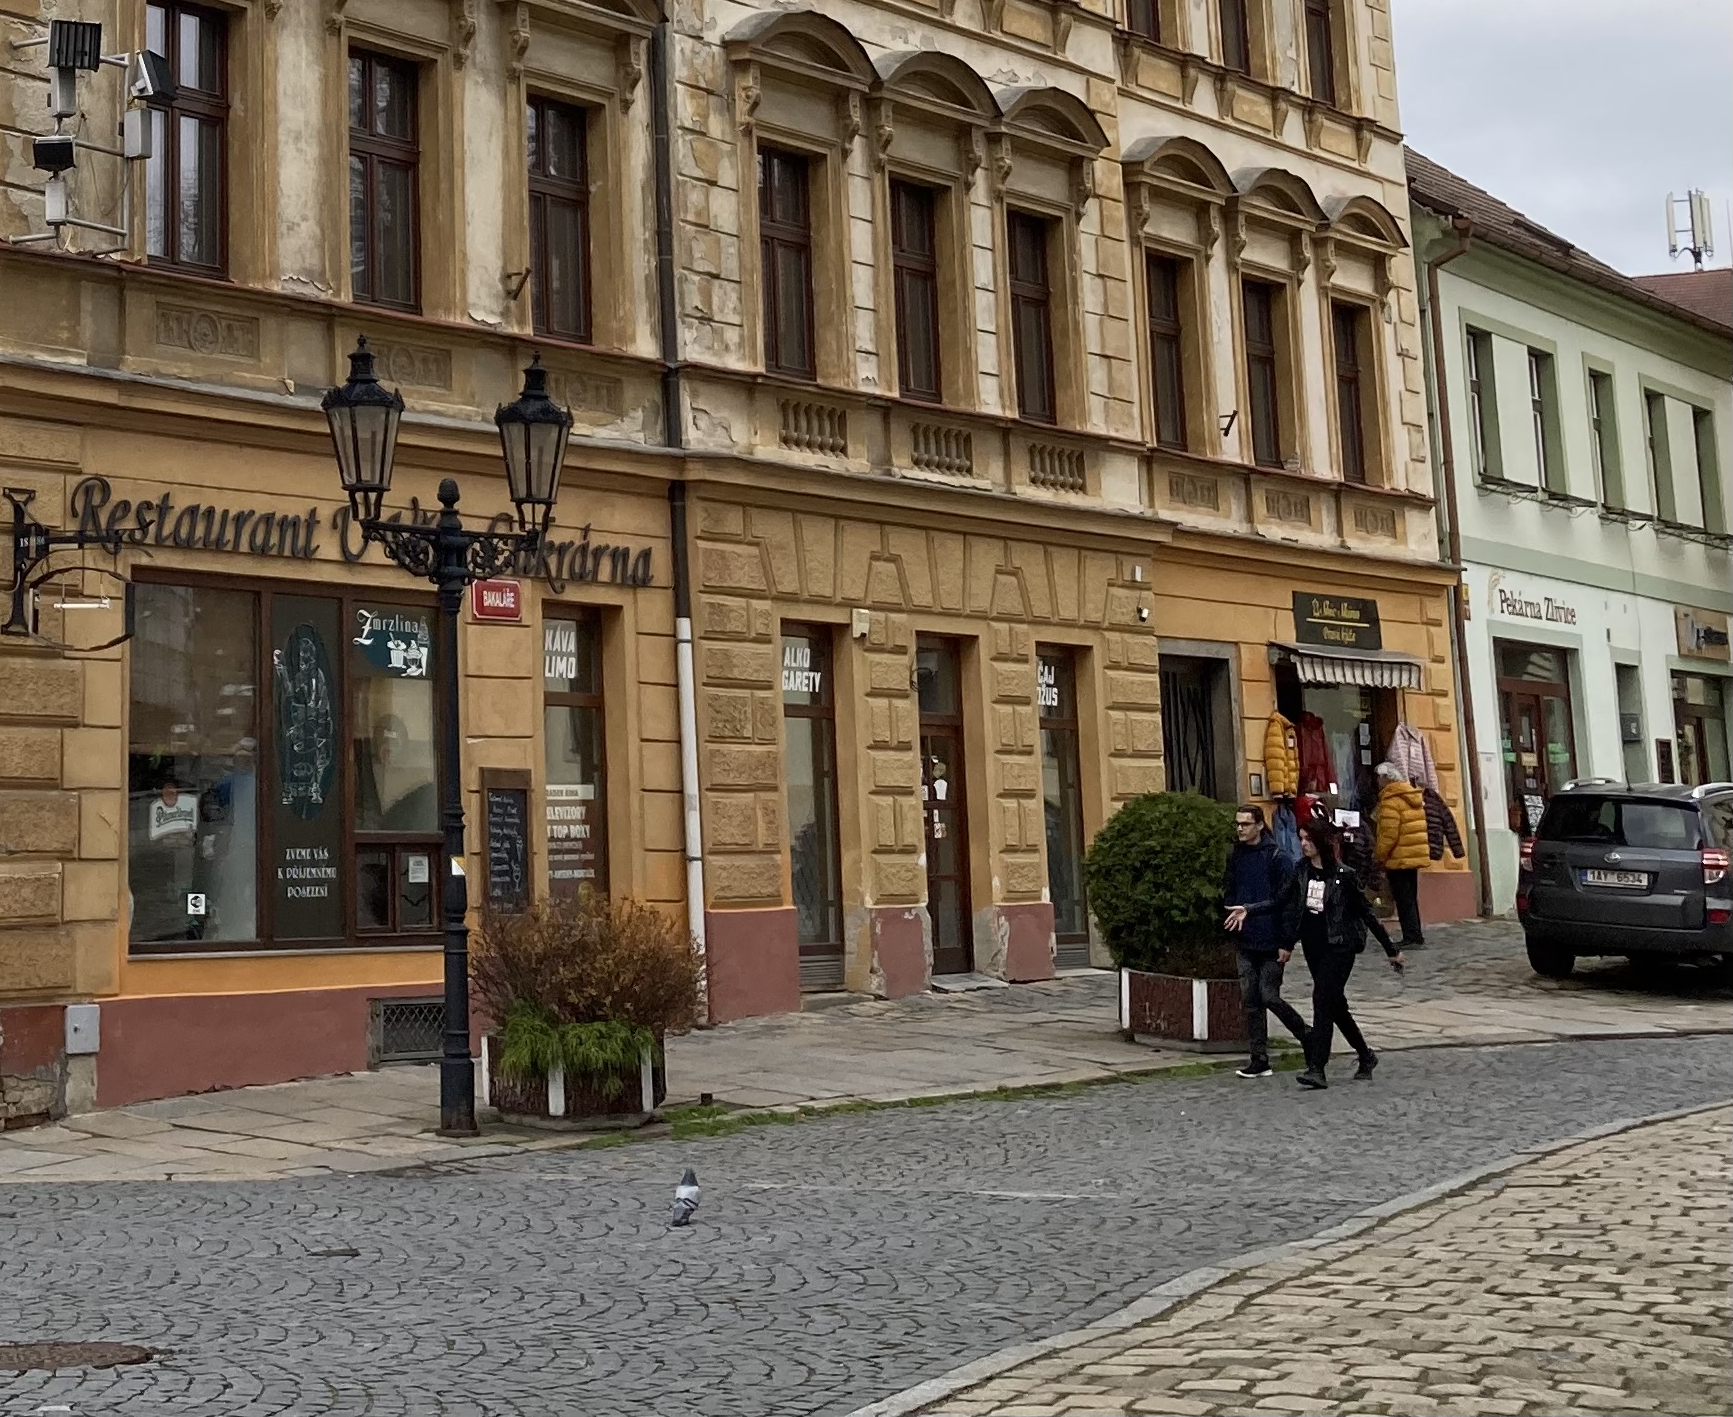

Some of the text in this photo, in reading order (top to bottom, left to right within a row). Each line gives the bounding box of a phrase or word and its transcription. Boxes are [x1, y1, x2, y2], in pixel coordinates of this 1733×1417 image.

[71, 476, 321, 559] Restaurant
[1498, 589, 1543, 620] Pekárna
[545, 624, 576, 653] KÁVA
[545, 656, 577, 679] LIMO
[783, 647, 811, 668] ALKO
